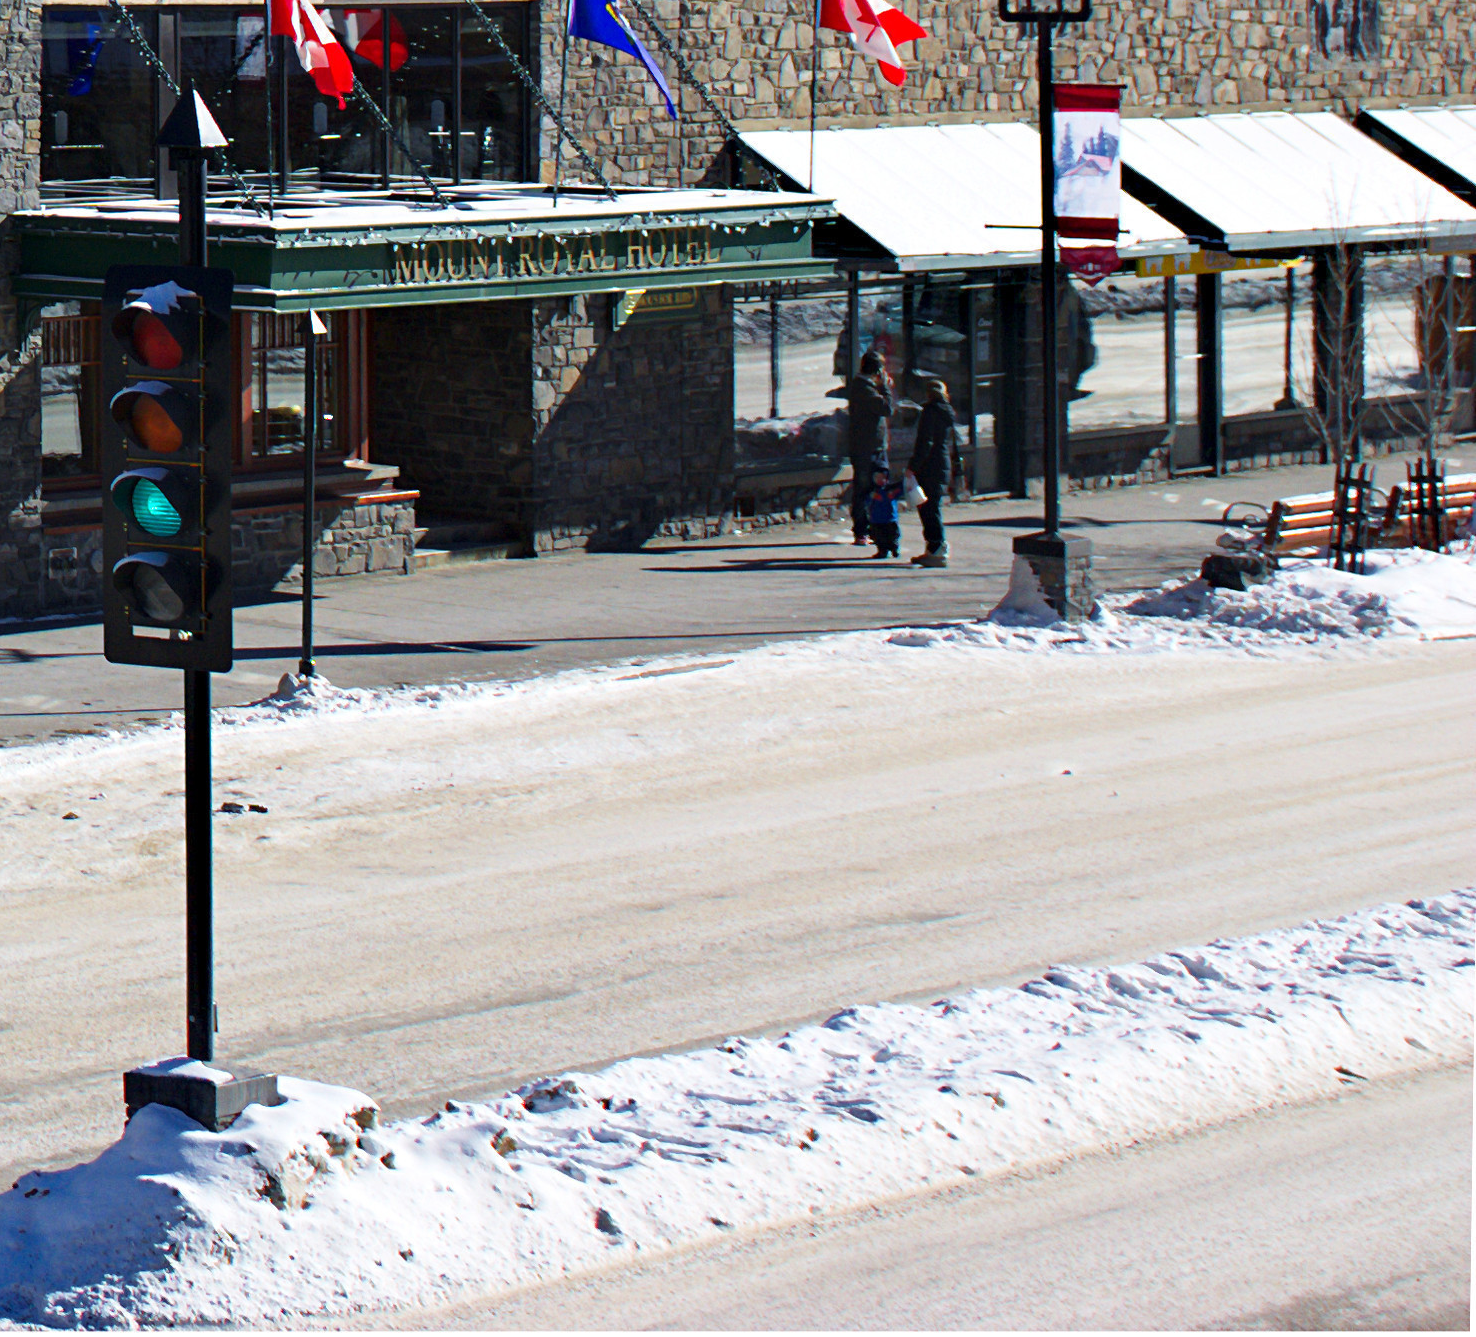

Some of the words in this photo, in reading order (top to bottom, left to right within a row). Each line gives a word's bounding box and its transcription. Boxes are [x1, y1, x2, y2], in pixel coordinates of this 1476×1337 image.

[393, 237, 511, 283] MOUNT
[518, 232, 618, 276] ROYAL
[627, 226, 723, 269] HOTEL
